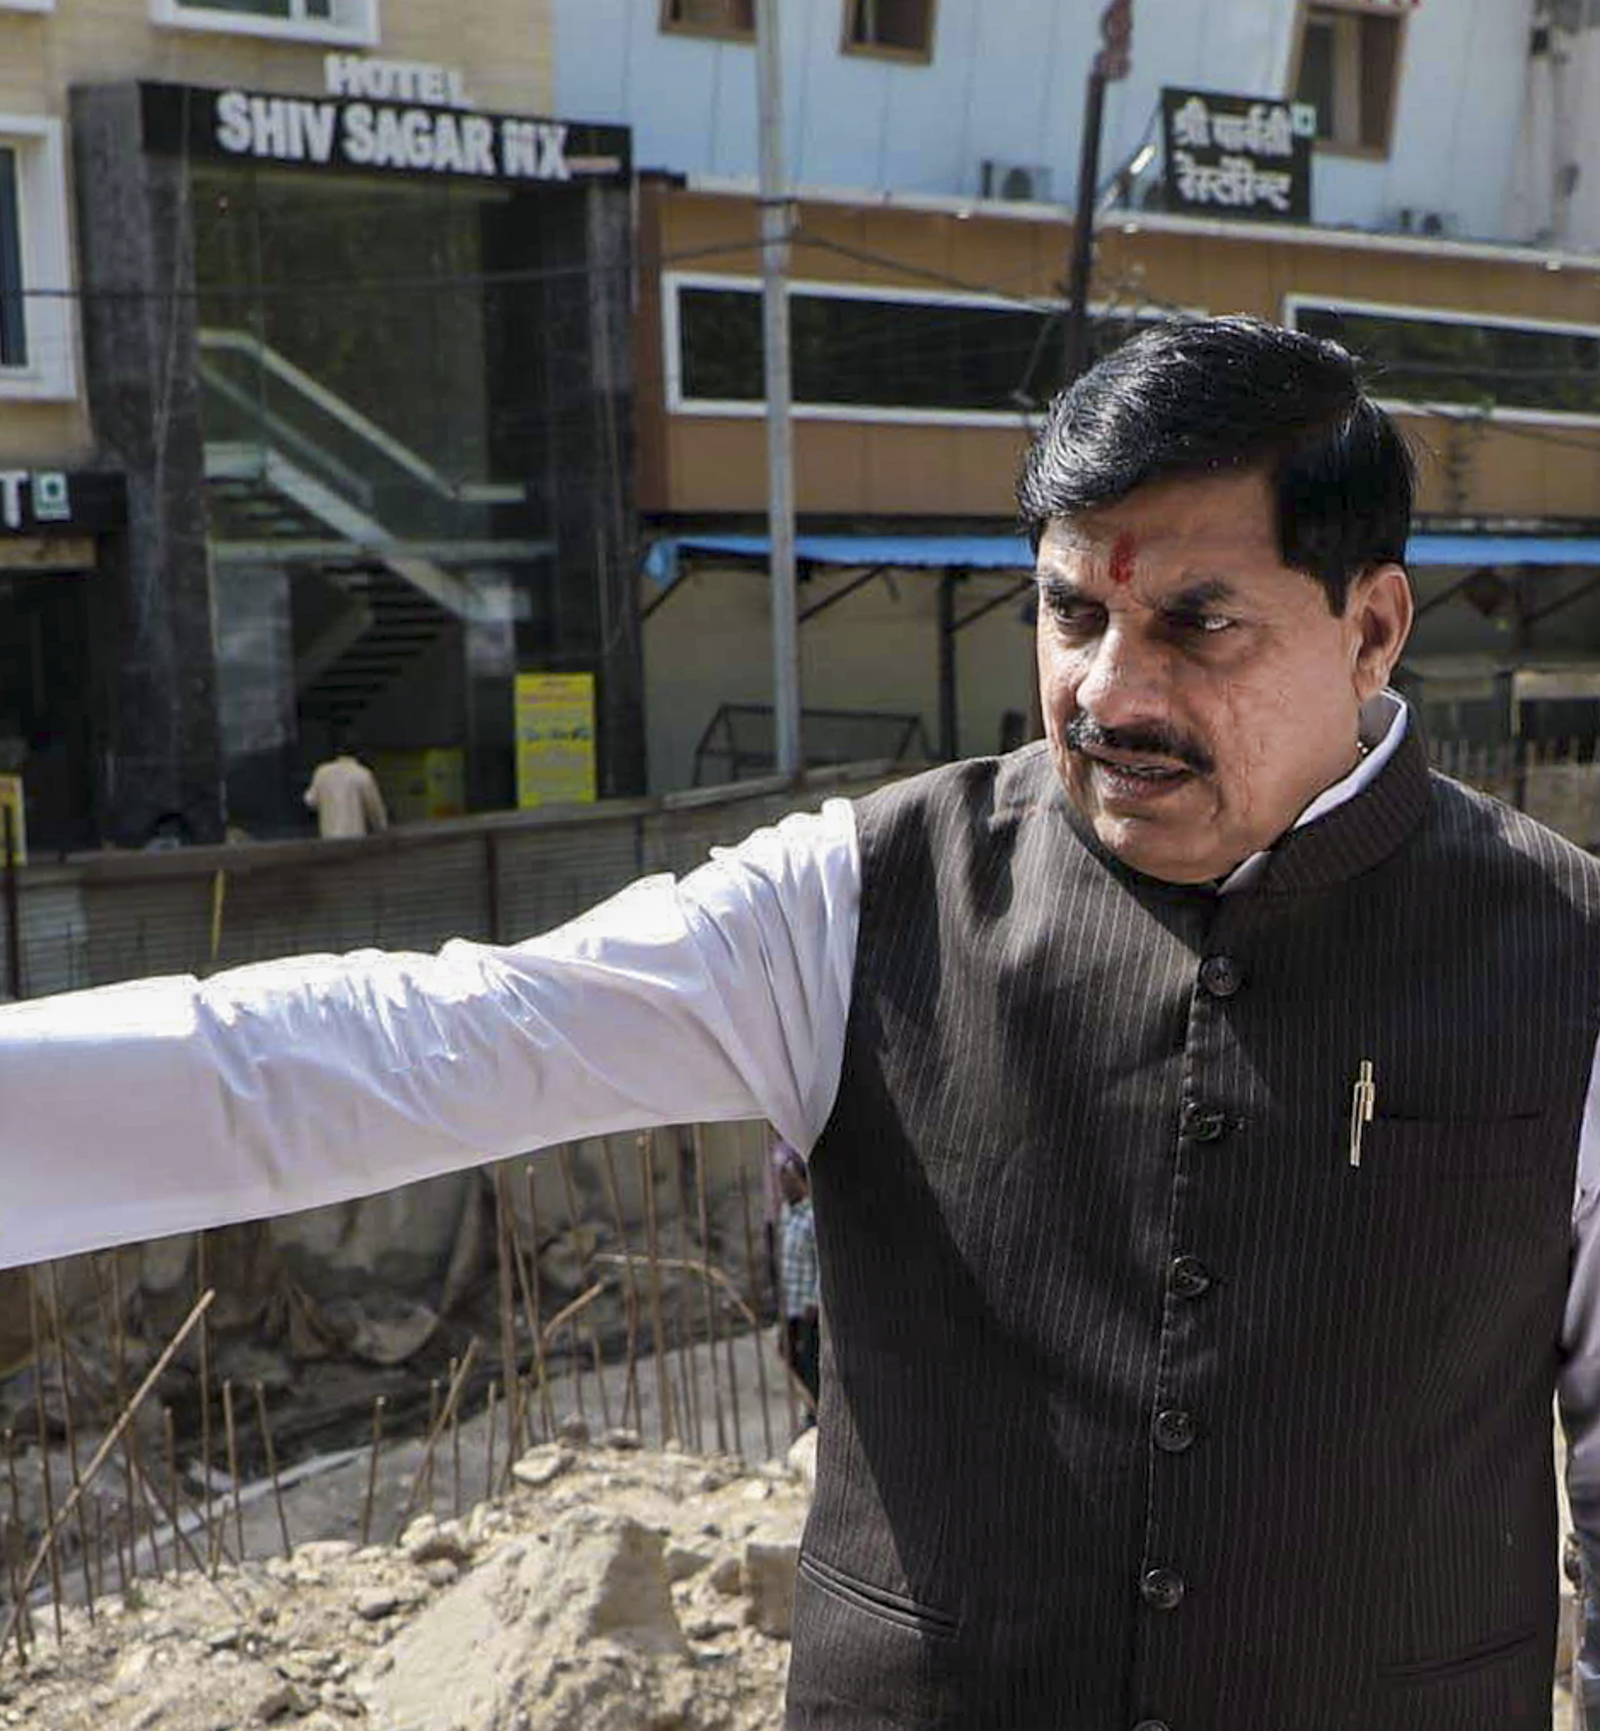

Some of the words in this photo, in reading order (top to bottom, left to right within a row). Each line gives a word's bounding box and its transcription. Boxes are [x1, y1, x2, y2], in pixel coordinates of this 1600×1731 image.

[324, 53, 475, 109] HOTEL
[217, 91, 336, 163] SHIV
[343, 103, 496, 176] SAGAR
